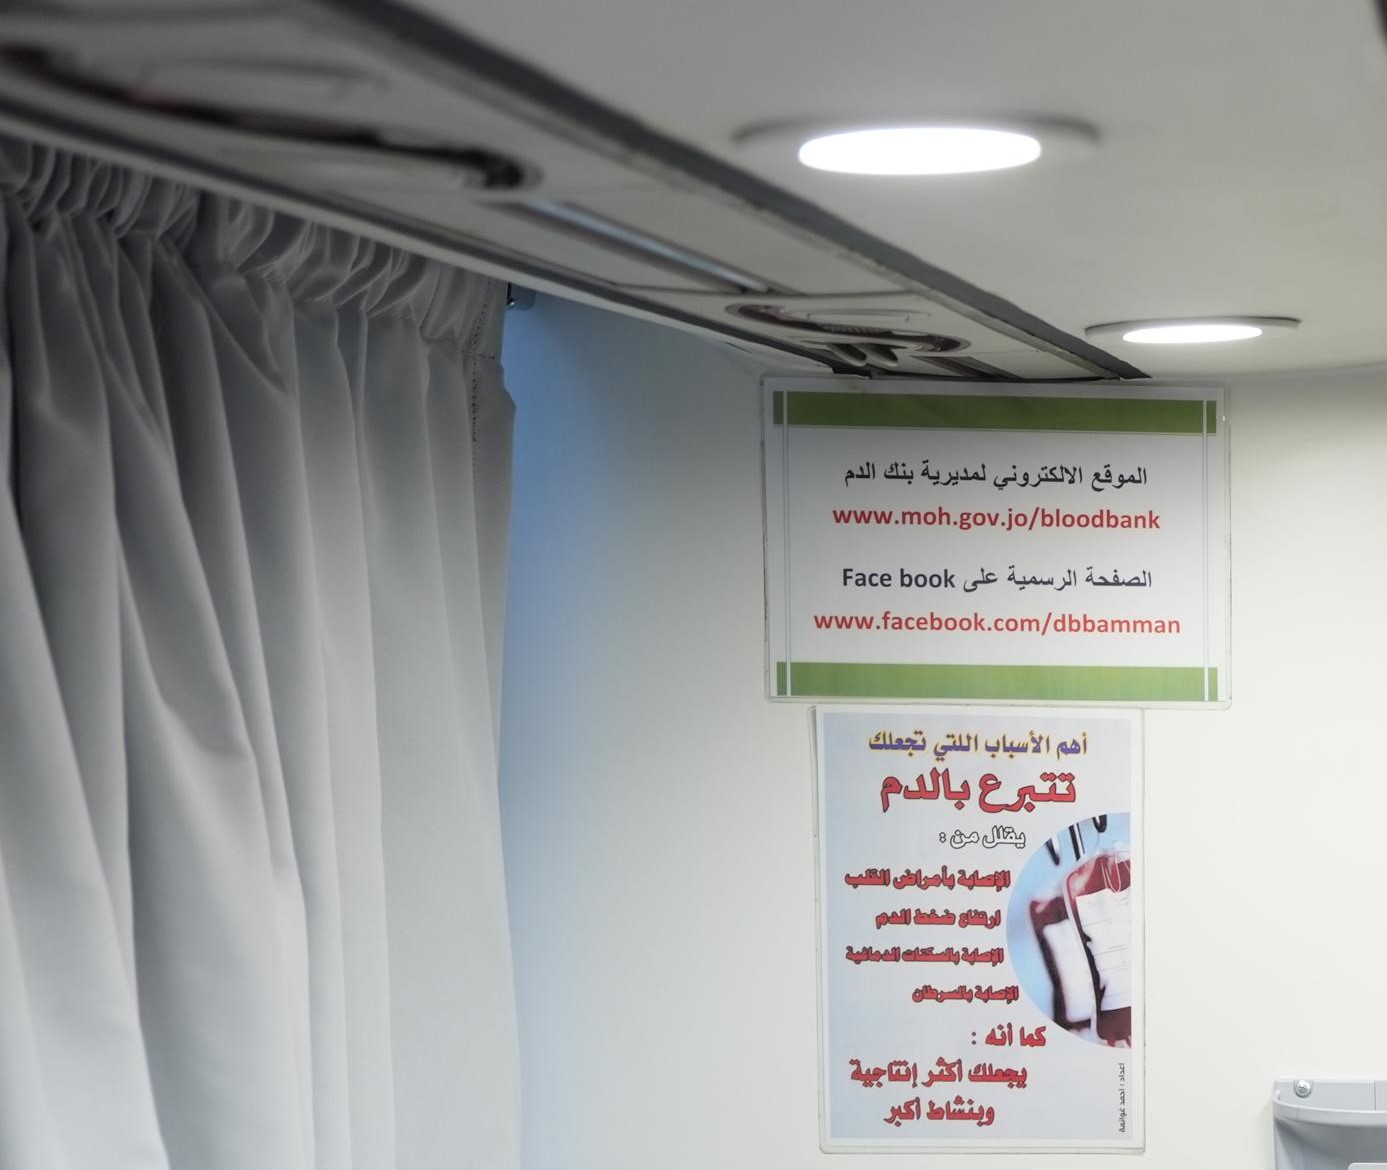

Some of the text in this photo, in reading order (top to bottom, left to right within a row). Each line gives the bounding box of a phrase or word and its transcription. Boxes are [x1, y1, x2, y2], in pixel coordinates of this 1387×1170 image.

[845, 459, 1146, 492] الموقع الالكتروني لمديرية بنك الدم
[832, 506, 1161, 533] www.moh.gov.jo/bloodbank
[843, 565, 1151, 592] الصفحة الرسمية على Face book
[813, 611, 1179, 635] www.facebook.com/dbbamman
[869, 730, 1087, 762] أهم الأسباب اللتي تجعلك
[880, 767, 1076, 813] تتبرع بالدم
[950, 829, 980, 849] من
[982, 825, 1026, 849] يقلل
[844, 865, 1011, 892] الإصابة بأمراض القلب
[875, 908, 1001, 929] ارتفاع ضغط الدم
[846, 946, 1004, 967] الإصابة بالسكتات الدماغية
[912, 985, 1019, 1004] الإصابة بالسرطان
[985, 1023, 1013, 1046] أنه
[1020, 1026, 1046, 1047] كما
[849, 1057, 1027, 1089] يجعلك أكثر إنتاجية
[884, 1095, 995, 1127] وبنشاط أكبر
